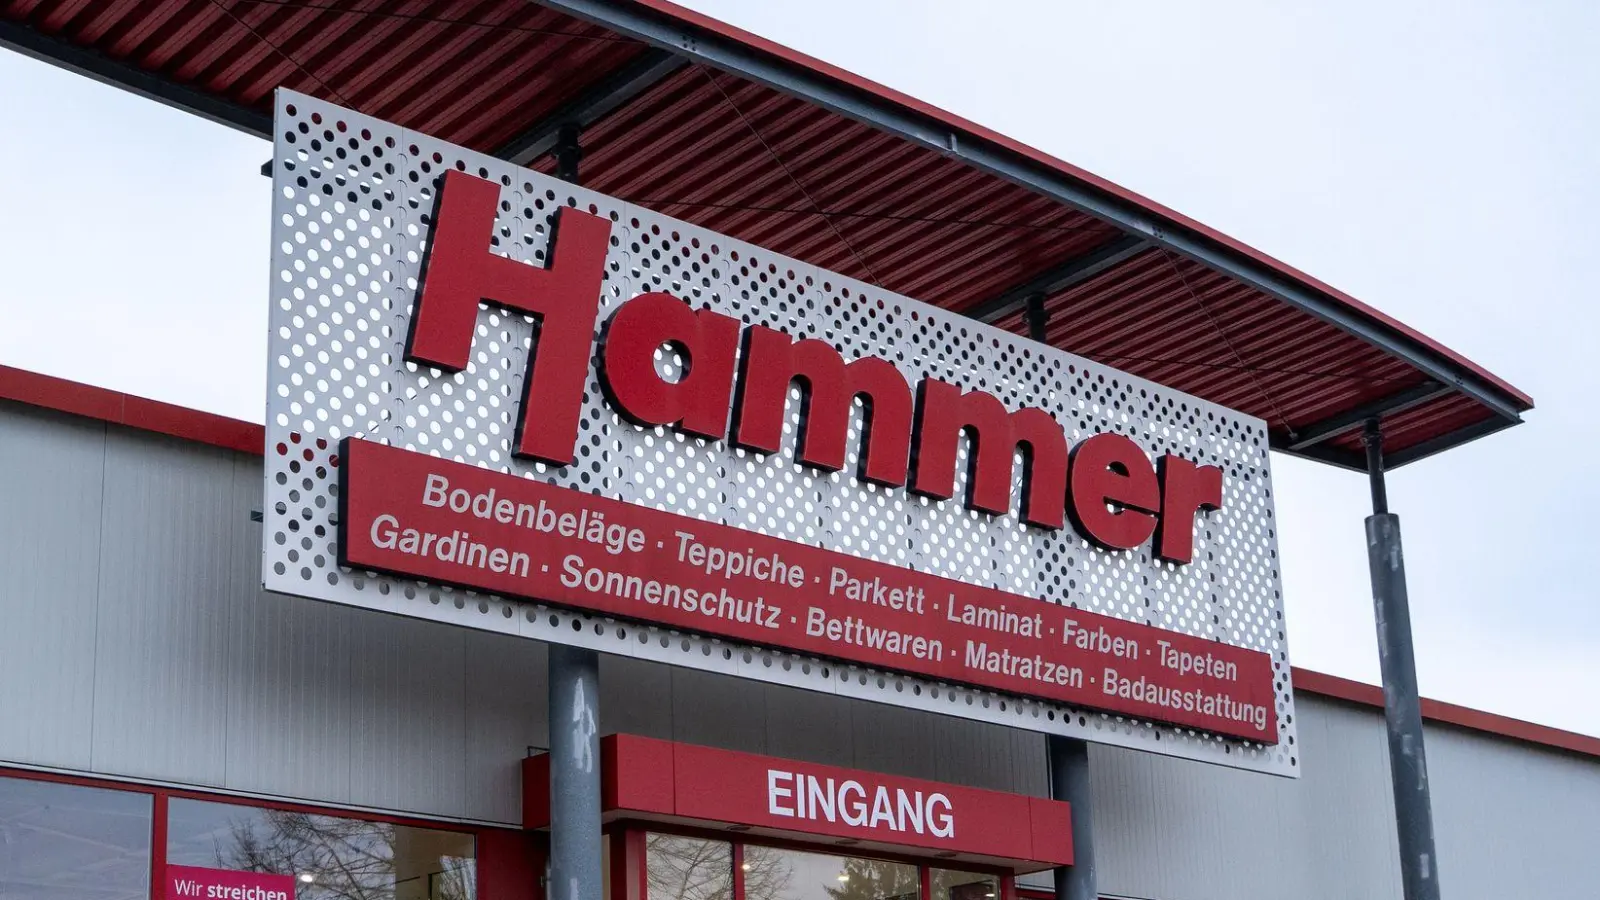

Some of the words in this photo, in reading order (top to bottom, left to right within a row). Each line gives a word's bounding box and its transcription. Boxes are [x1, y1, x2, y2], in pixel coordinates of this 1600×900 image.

[405, 169, 1222, 564] Hammer
[369, 513, 531, 579] Gardinen
[559, 554, 782, 630] Sonnenschutz
[805, 606, 943, 662] Bettwaren
[964, 640, 1084, 689] Matratzen
[1102, 667, 1268, 731] Badausstattung
[421, 473, 646, 555] Bodenbeläge
[674, 530, 806, 589] Teppiche
[829, 566, 926, 615] Parkett
[947, 593, 1043, 640] Laminat
[1062, 619, 1139, 660] Farben
[1156, 639, 1238, 682] Tapeten
[174, 879, 203, 897] Wir
[207, 884, 287, 900] streichen
[767, 769, 955, 839] EINGANG
